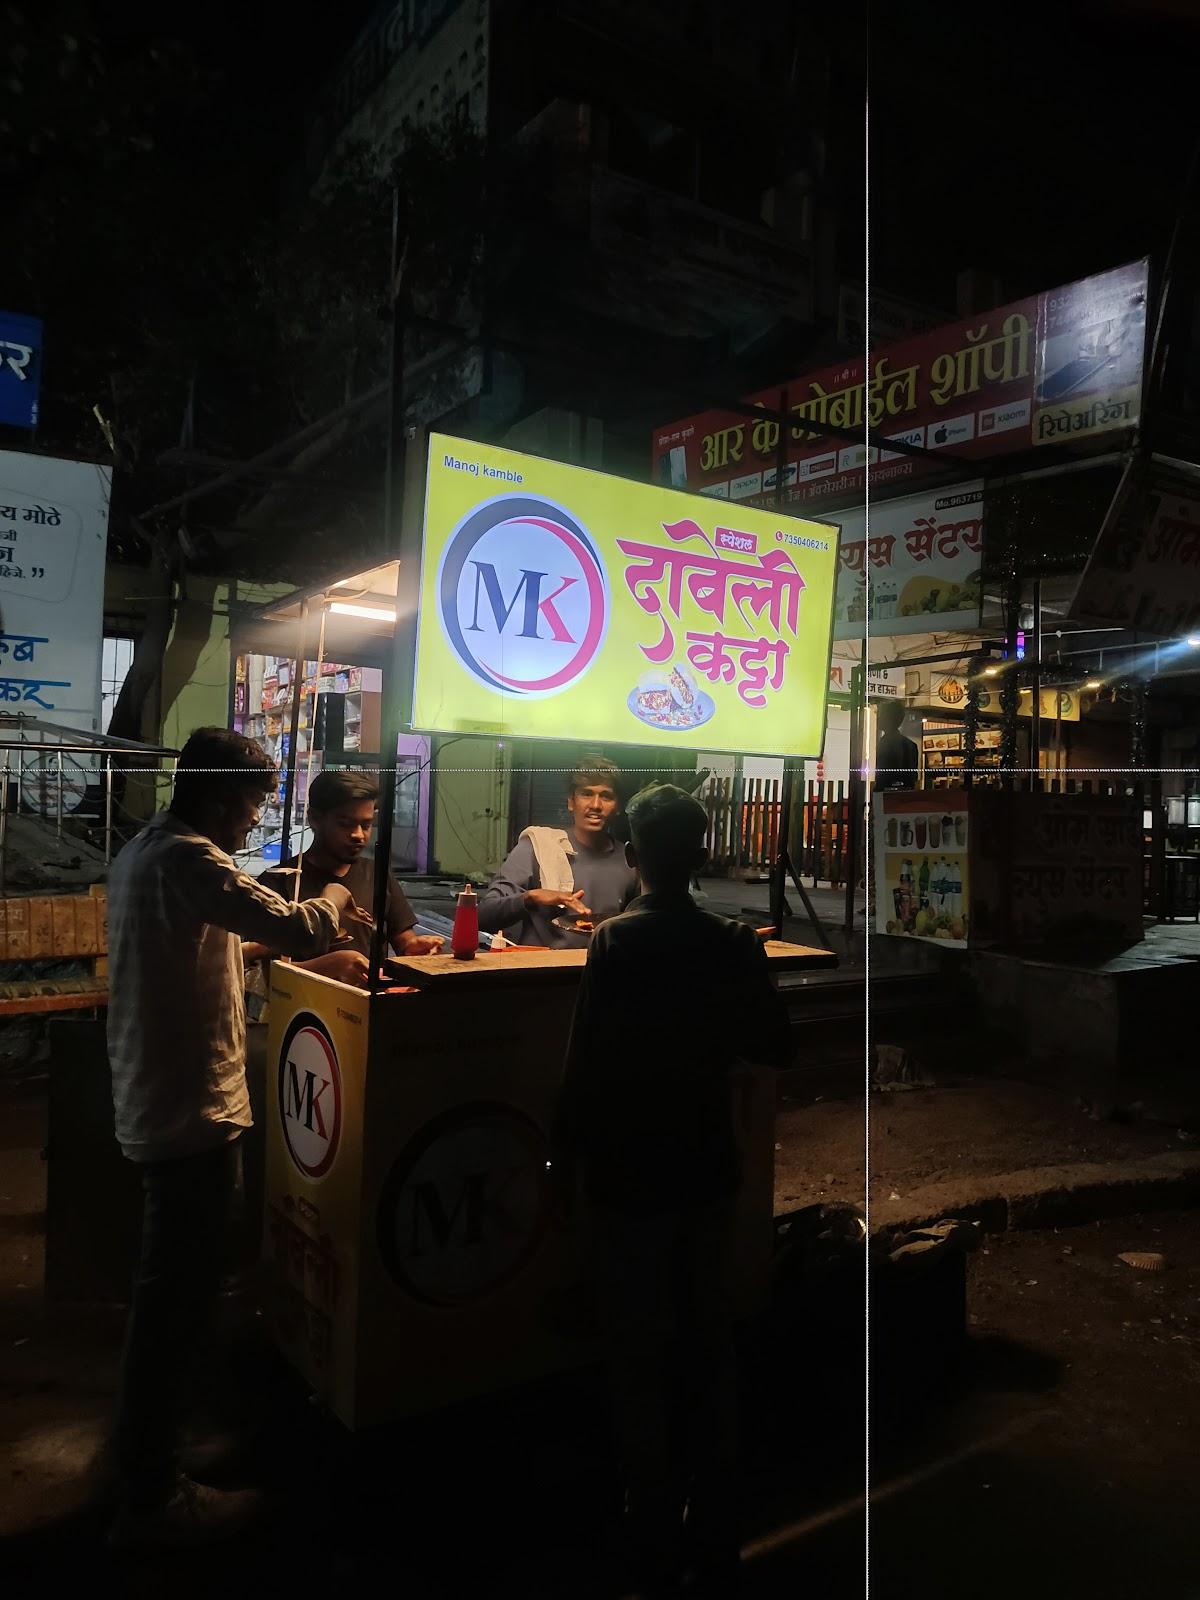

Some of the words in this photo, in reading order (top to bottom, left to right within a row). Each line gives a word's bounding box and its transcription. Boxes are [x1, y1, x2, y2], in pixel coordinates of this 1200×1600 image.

[0, 340, 34, 382] र
[700, 423, 745, 471] आर
[930, 313, 1032, 406] शॉपी
[1039, 398, 1132, 439] रिपेअरिंग
[444, 455, 480, 477] Manoj
[483, 464, 523, 483] kamble
[22, 504, 62, 526] मोठे
[783, 533, 829, 551] 7350406214
[904, 517, 984, 562] सेंटर
[464, 560, 579, 644] MK
[686, 631, 790, 708] कट्टा
[285, 1060, 331, 1141] MK
